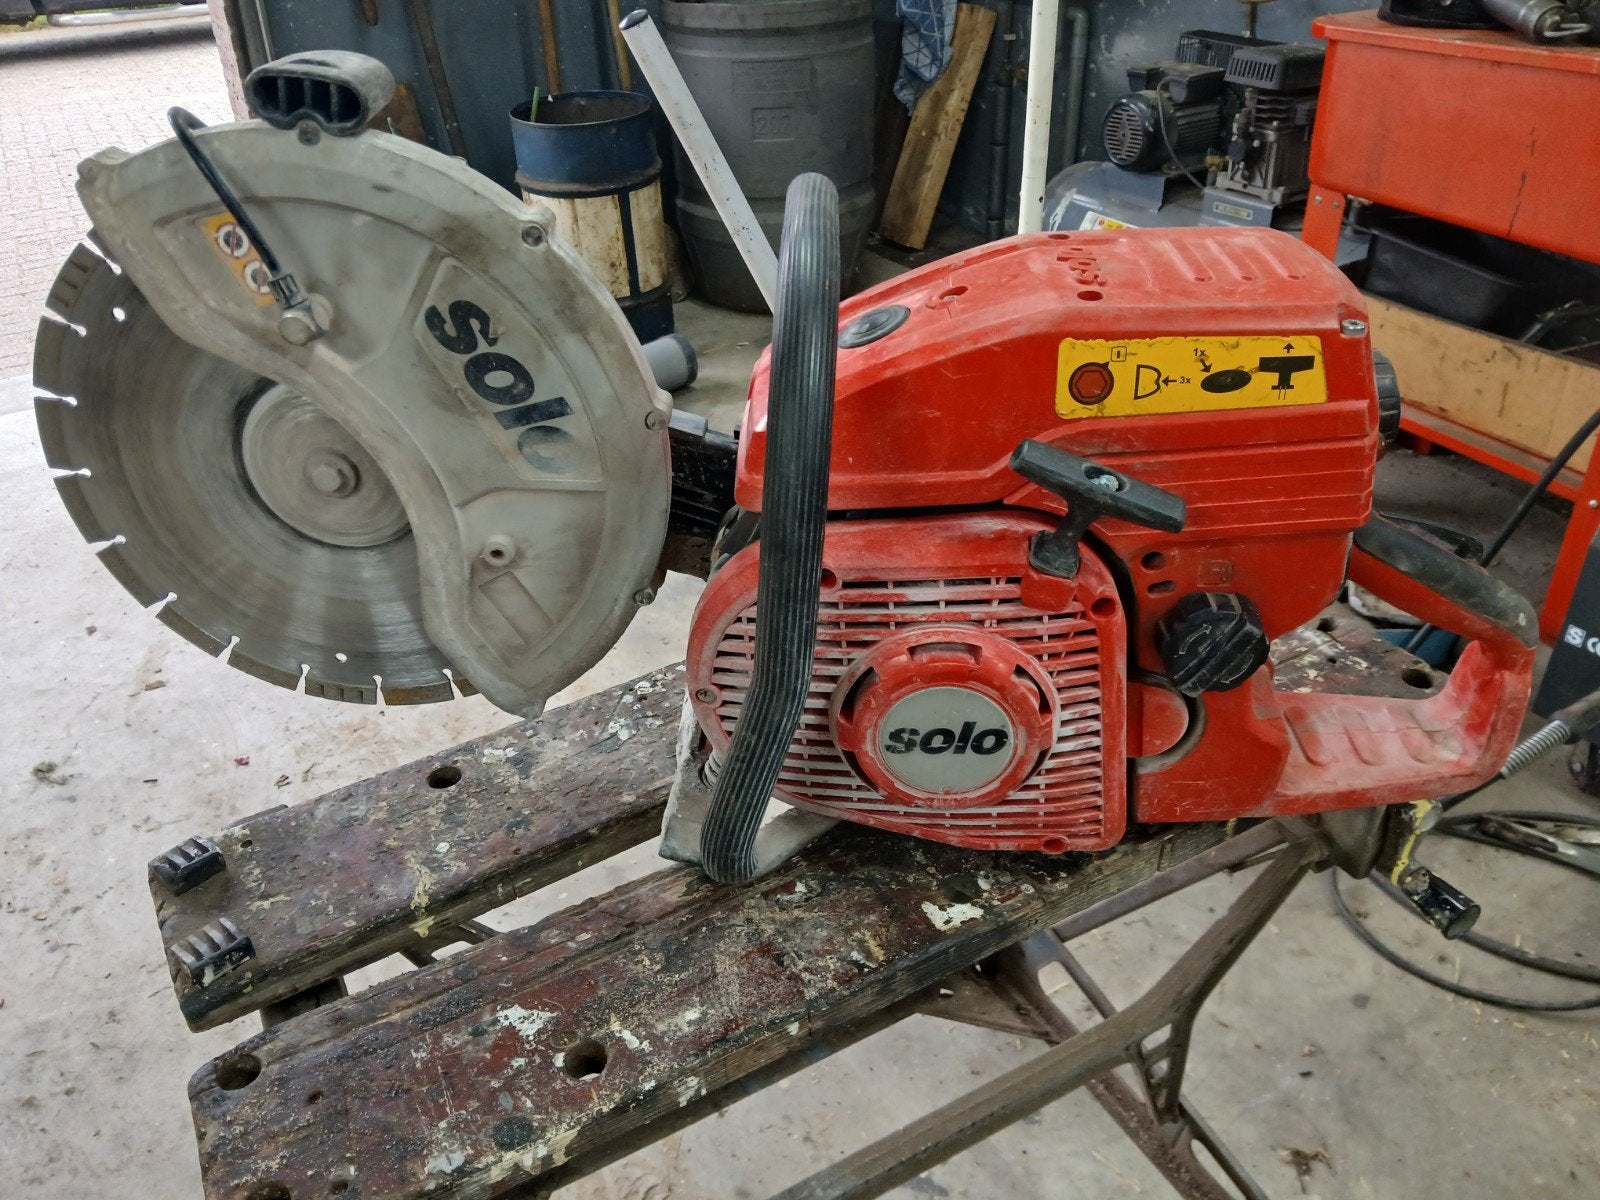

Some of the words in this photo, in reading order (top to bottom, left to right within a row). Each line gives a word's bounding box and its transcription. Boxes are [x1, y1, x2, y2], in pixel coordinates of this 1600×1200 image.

[1193, 347, 1206, 357] 1x
[425, 300, 580, 474] solo
[1179, 376, 1191, 384] 3x
[884, 720, 1009, 755] solo
